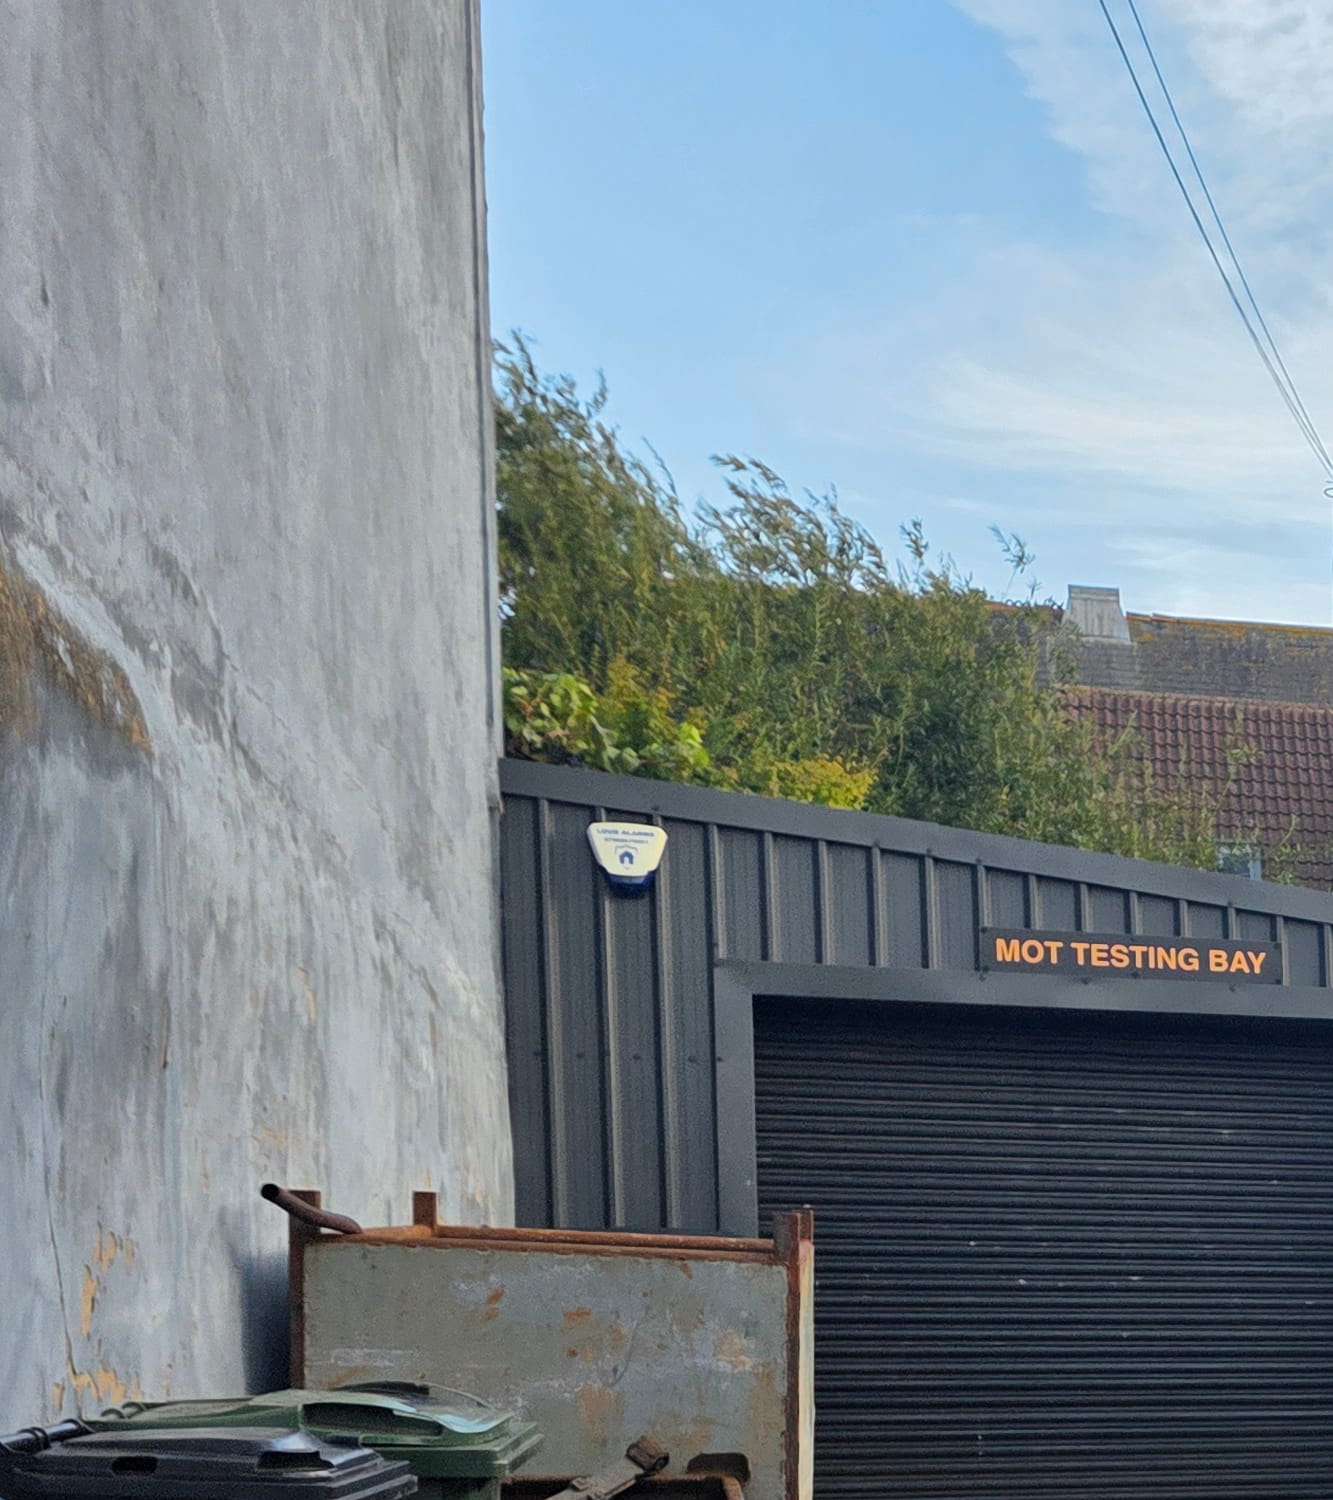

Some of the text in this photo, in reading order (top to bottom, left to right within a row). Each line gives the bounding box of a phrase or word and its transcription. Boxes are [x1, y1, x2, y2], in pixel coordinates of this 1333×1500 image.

[995, 938, 1267, 975] MOT TESTING BAY
